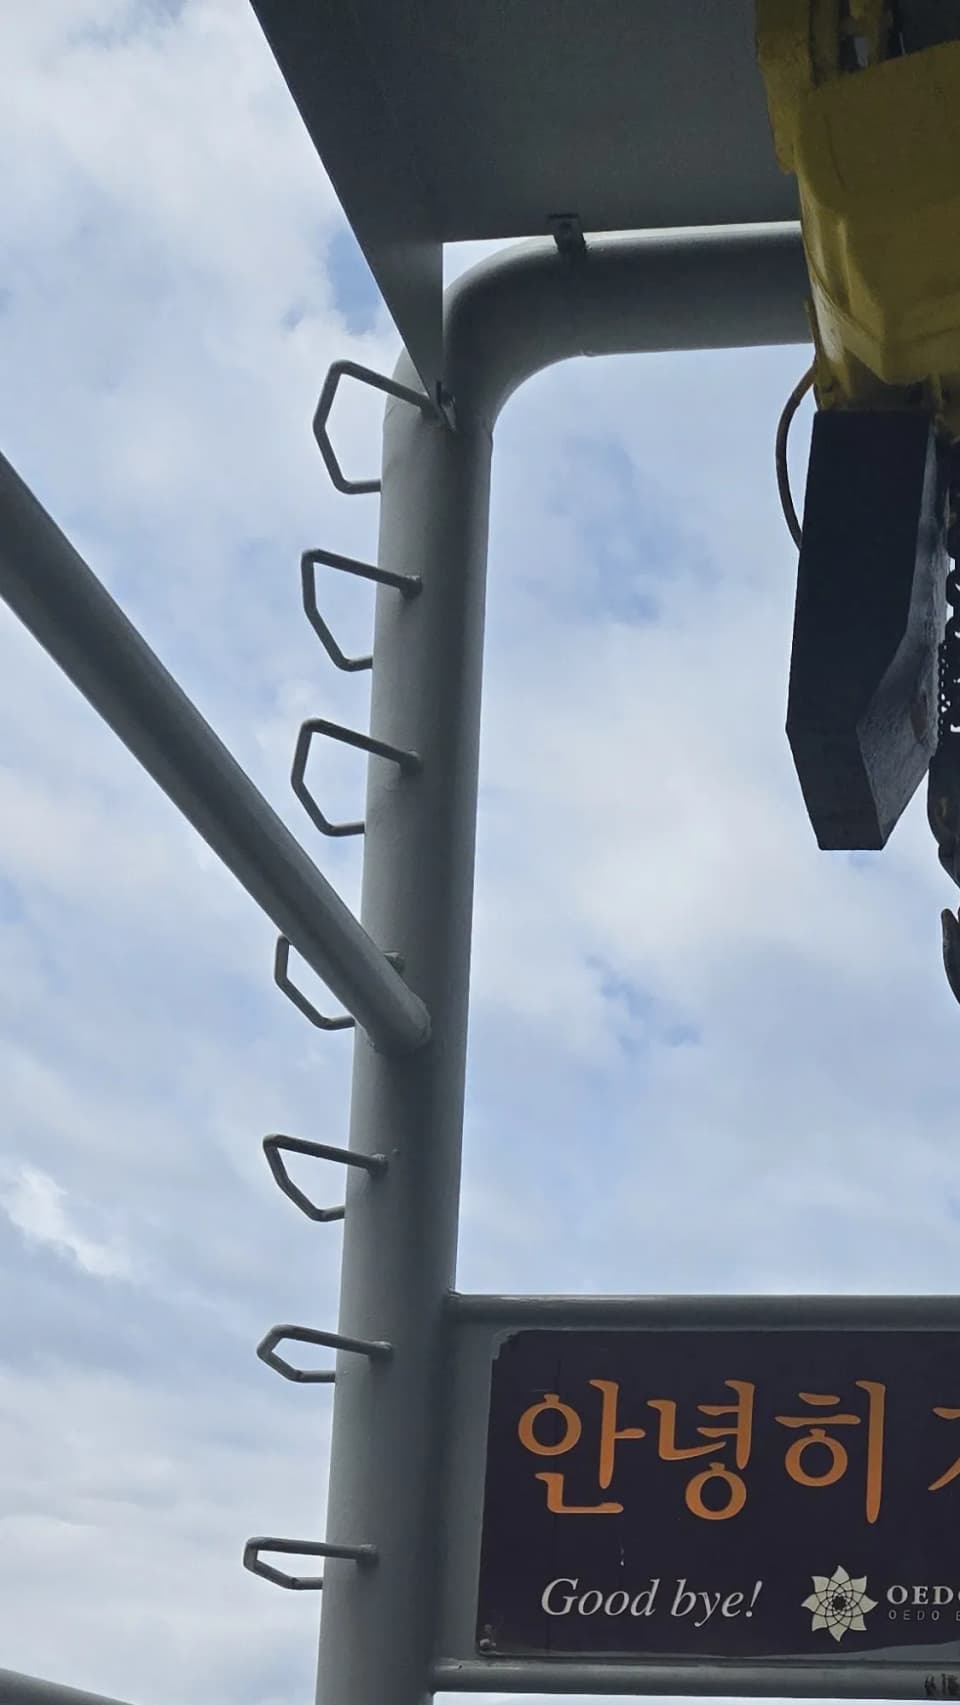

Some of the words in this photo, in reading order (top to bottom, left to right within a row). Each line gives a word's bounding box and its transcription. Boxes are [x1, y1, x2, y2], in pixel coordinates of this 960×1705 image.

[518, 1379, 886, 1524] 안녕히
[540, 1577, 661, 1618] Good
[670, 1578, 764, 1627] bye!
[888, 1609, 941, 1622] OEDO
